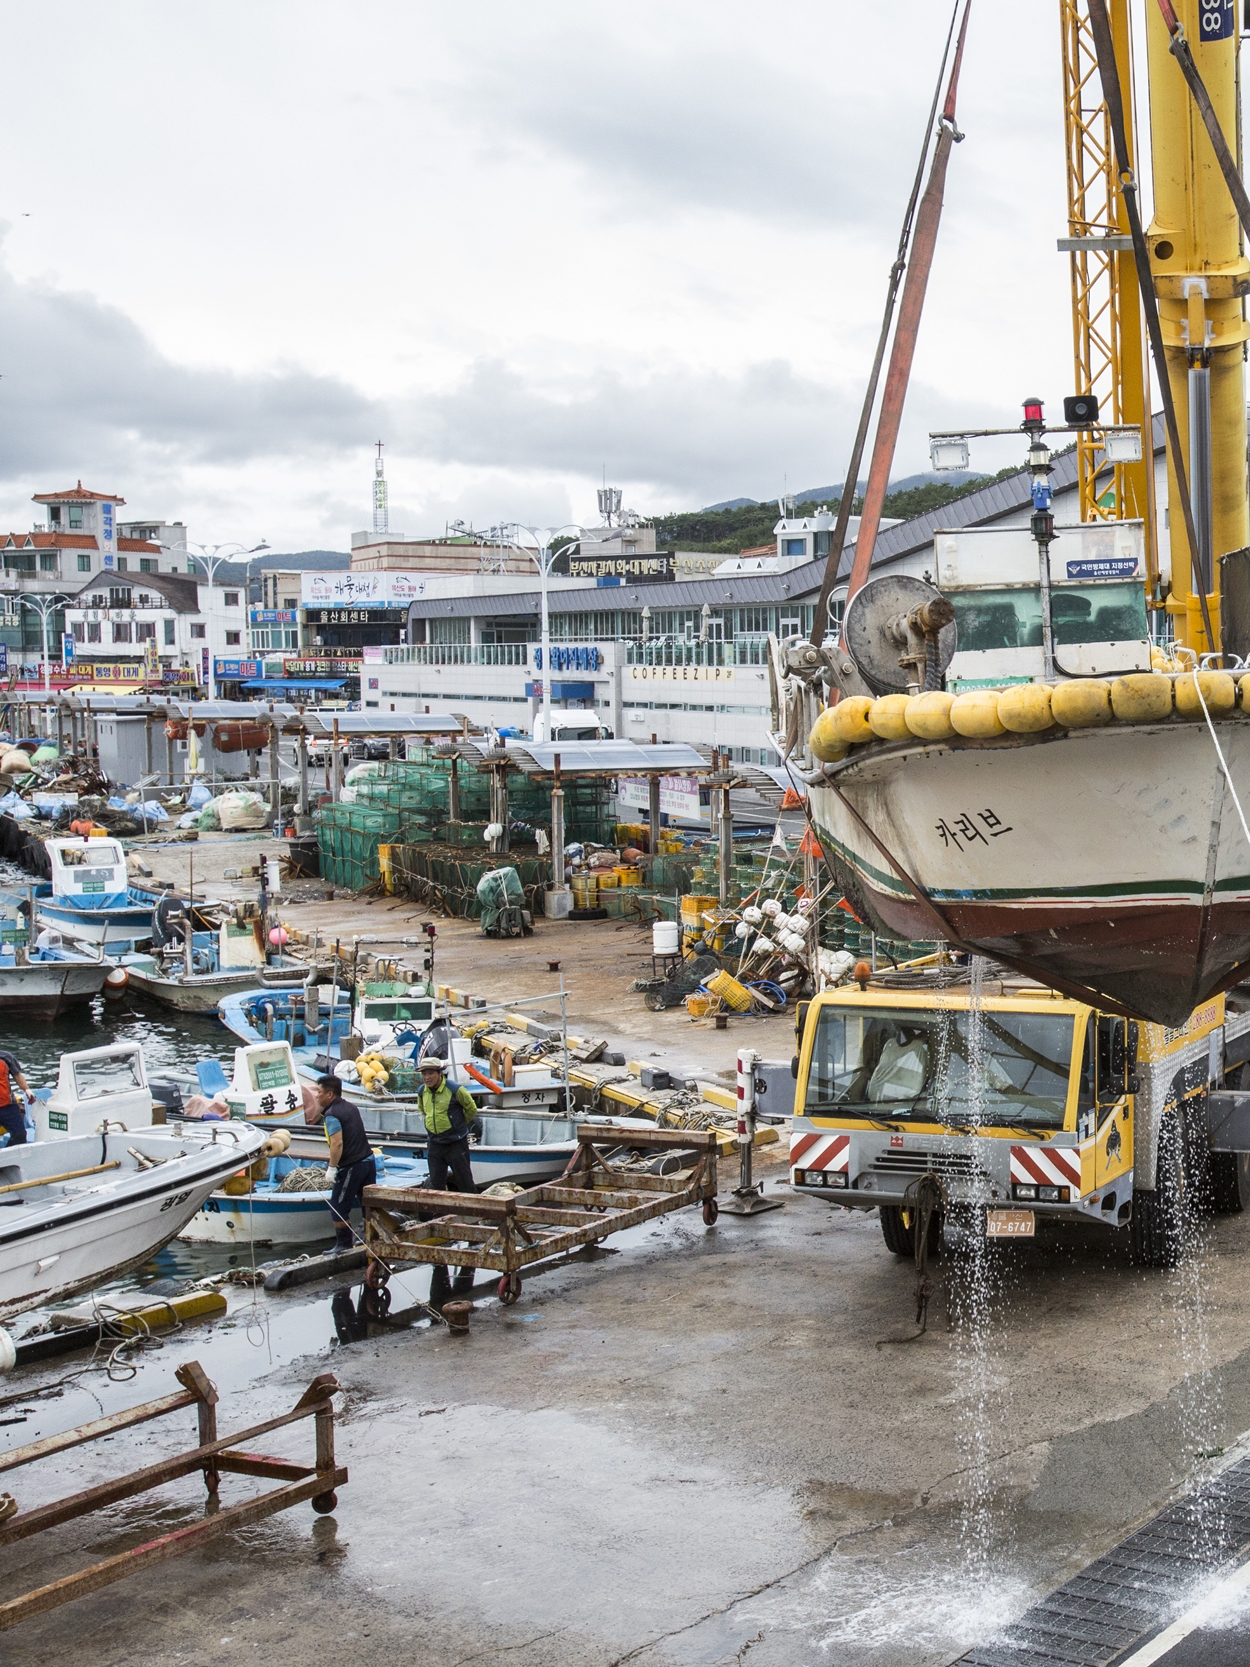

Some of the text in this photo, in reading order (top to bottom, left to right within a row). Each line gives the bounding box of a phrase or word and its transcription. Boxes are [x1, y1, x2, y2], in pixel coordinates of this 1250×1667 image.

[102, 503, 114, 571] 팔각정회센
[320, 610, 369, 623] 울산회센타
[533, 646, 599, 672] 정활어직매장
[935, 808, 1013, 852] 카리브
[521, 1092, 545, 1104] 정자
[989, 1221, 1032, 1233] 07-6747
